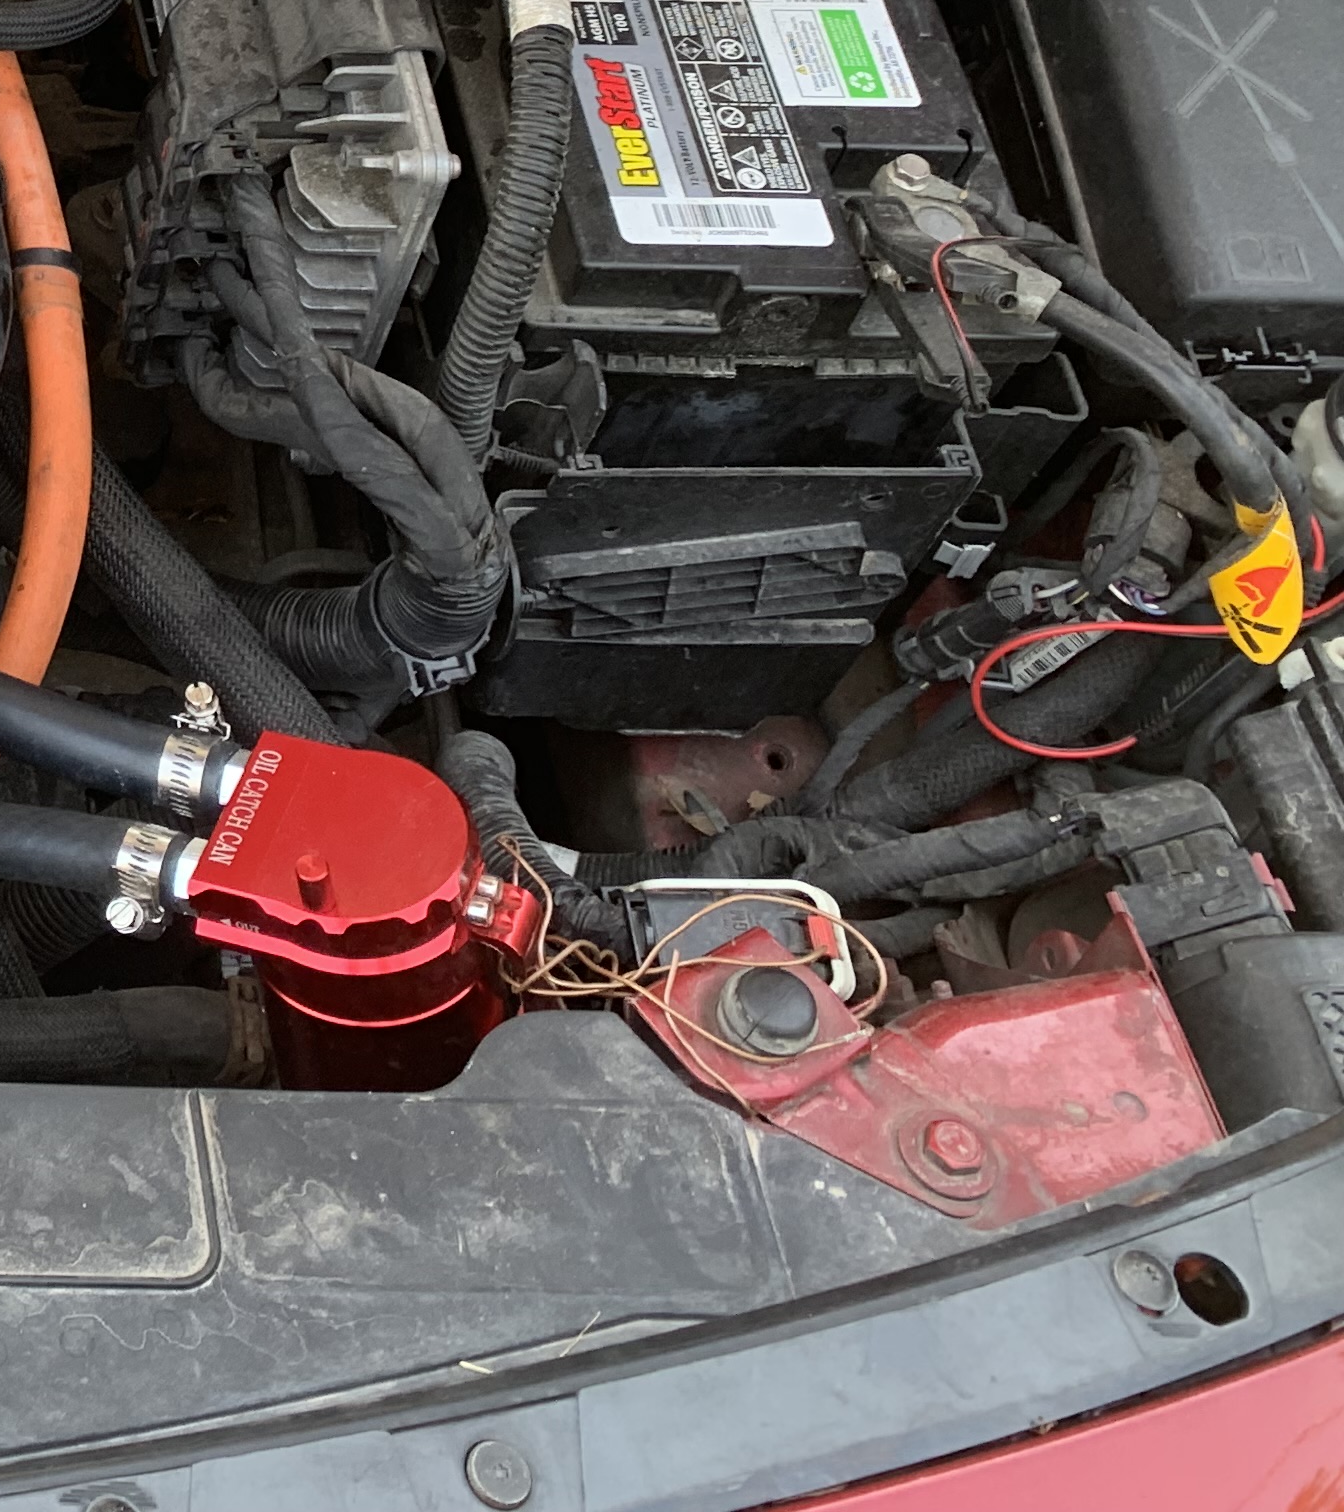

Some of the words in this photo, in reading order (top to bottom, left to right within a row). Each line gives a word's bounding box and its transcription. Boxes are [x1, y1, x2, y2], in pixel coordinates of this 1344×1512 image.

[582, 4, 598, 17] H5
[611, 13, 631, 32] 100
[586, 18, 606, 41] AGM
[628, 68, 660, 128] PLATINUM
[578, 58, 663, 186] EverStart
[683, 72, 728, 168] DANGER/POISON
[672, 130, 692, 156] Battery
[250, 749, 283, 775] OIL
[224, 778, 269, 831] CATCH
[208, 831, 243, 867] CAN
[235, 920, 261, 934] OUT
[732, 909, 748, 931] GM
